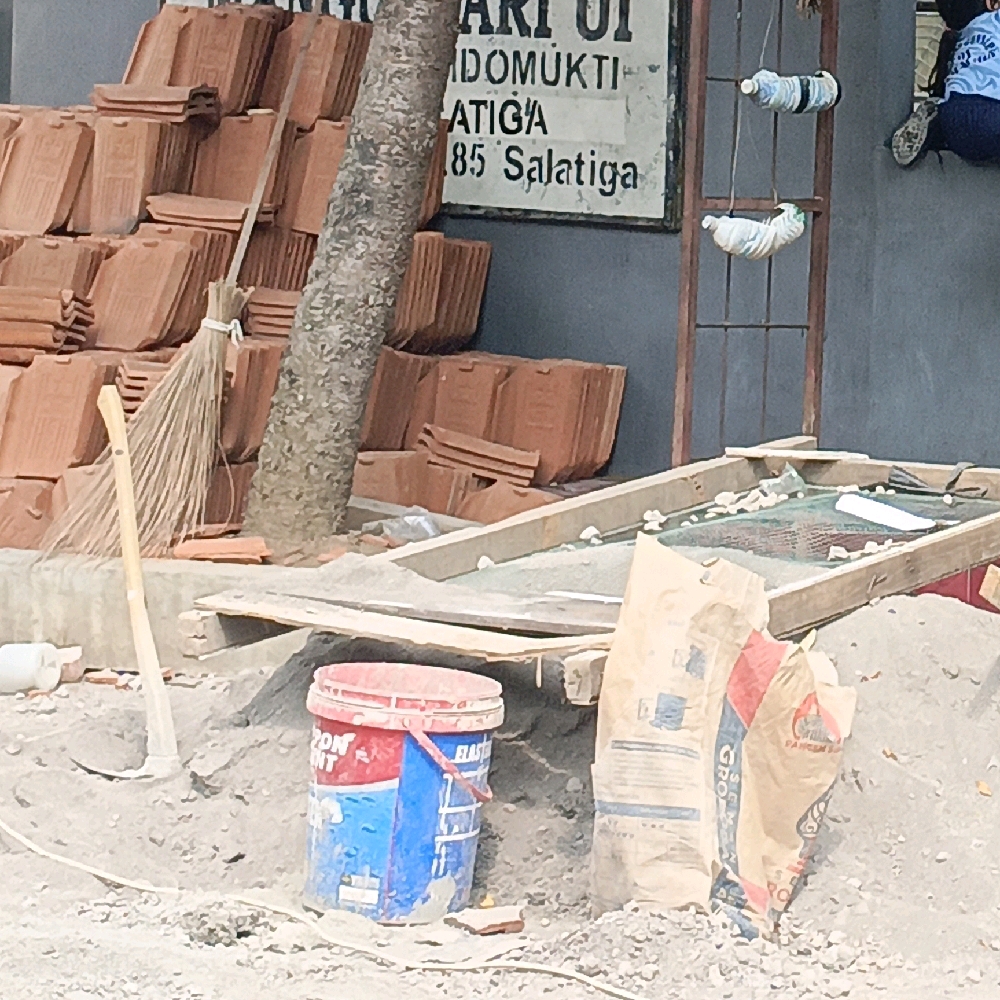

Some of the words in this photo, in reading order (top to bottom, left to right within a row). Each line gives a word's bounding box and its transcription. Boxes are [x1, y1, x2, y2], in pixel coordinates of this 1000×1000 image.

[452, 48, 620, 91] IDOMUKTI
[448, 99, 549, 136] ATIGA
[504, 145, 639, 197] Salatiga
